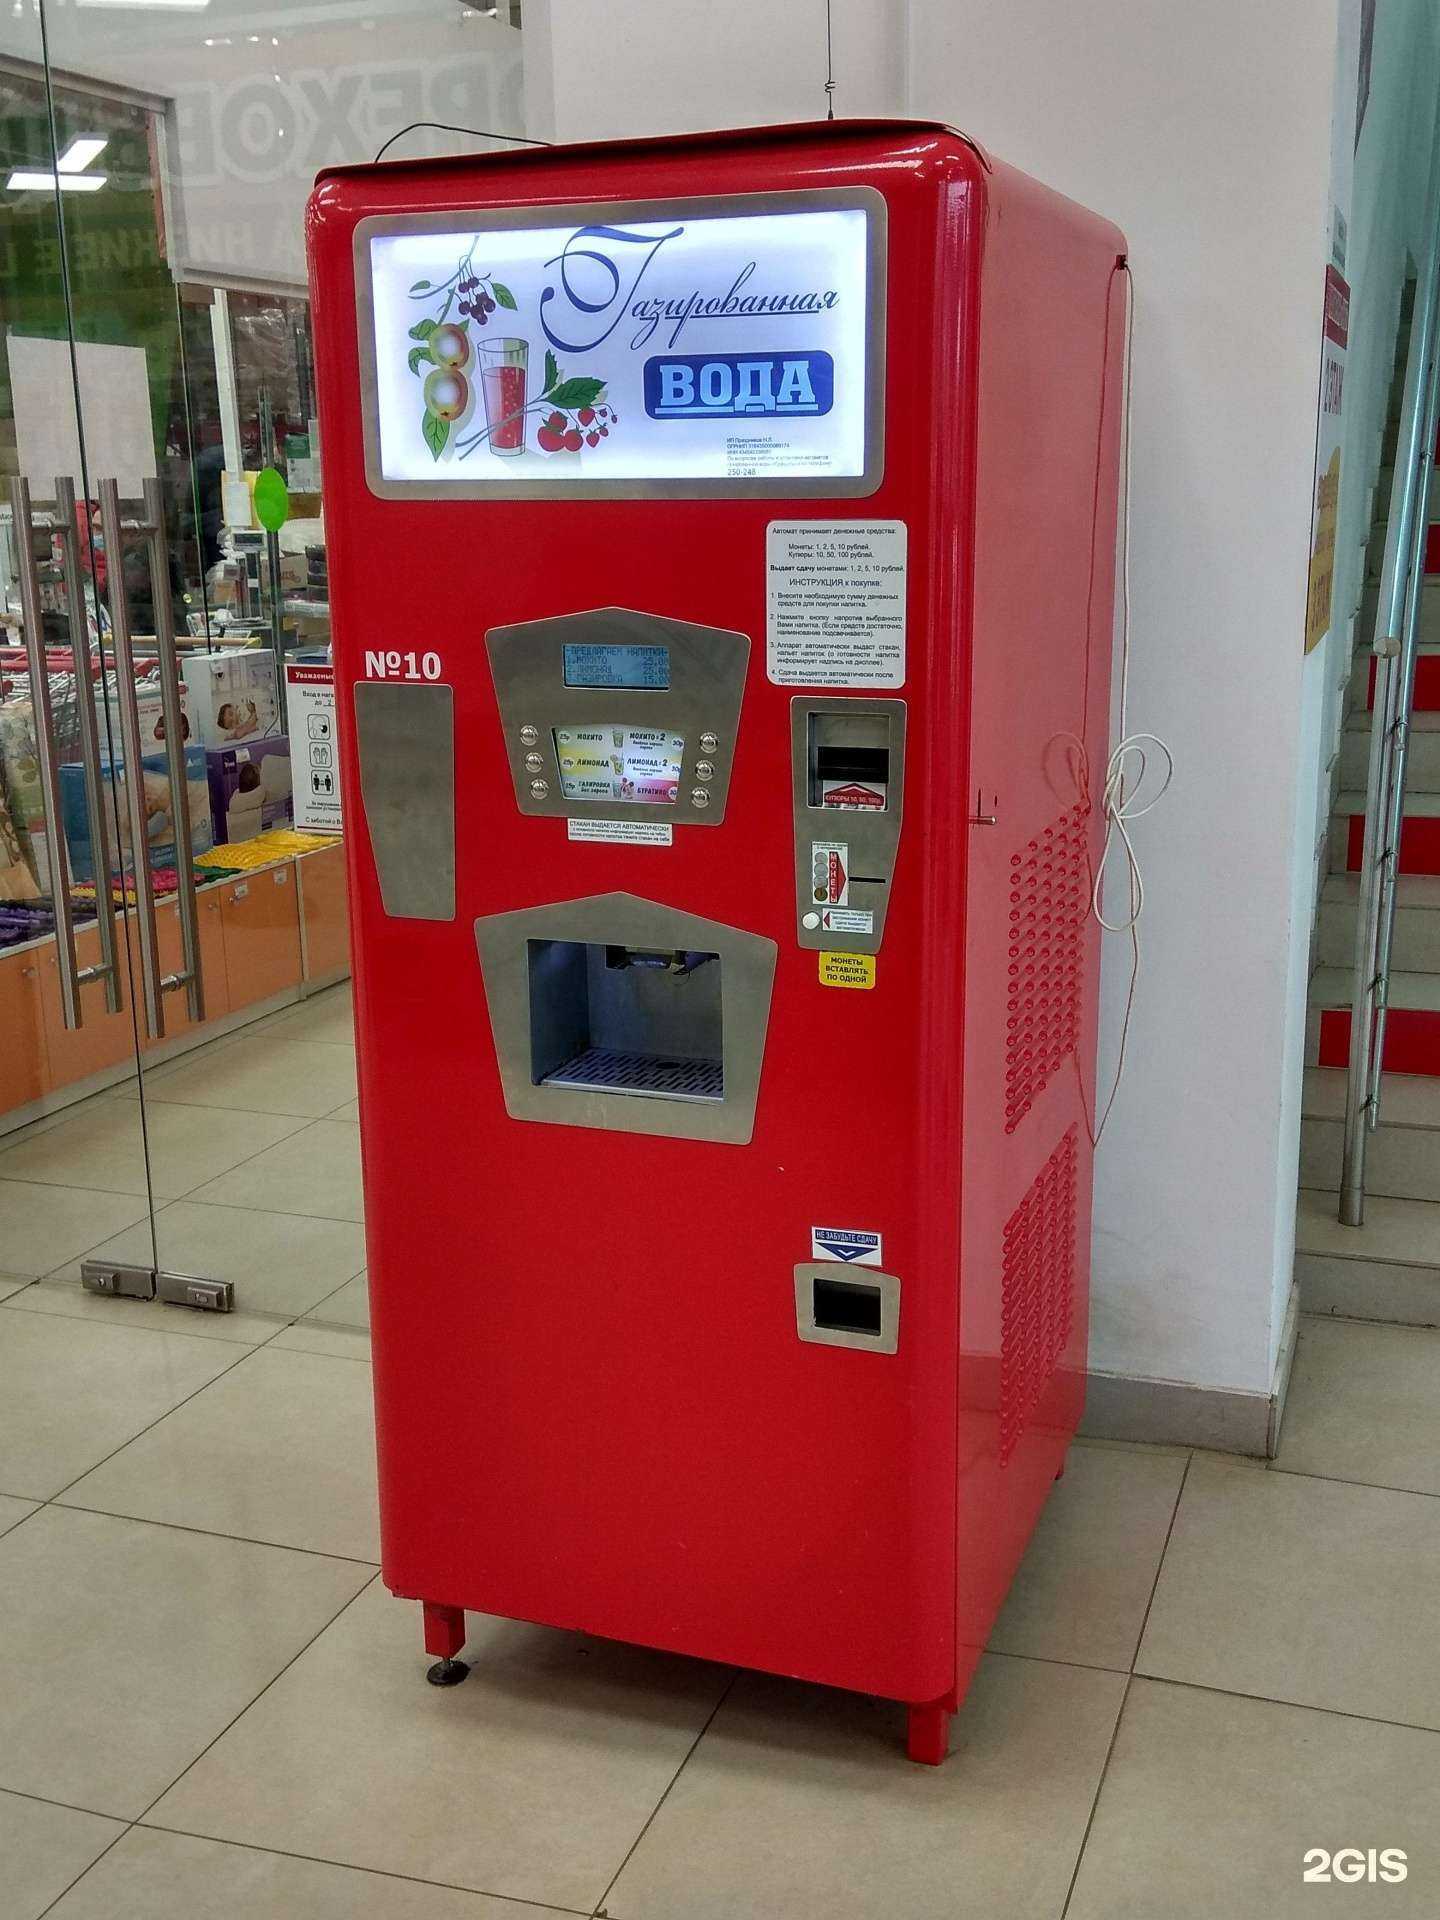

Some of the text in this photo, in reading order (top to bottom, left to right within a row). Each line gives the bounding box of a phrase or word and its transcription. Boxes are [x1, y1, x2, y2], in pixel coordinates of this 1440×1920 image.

[540, 226, 840, 353] Газированная
[657, 360, 817, 413] ВОДА
[789, 579, 843, 587] ИНСТРУКЦИЯ
[365, 651, 441, 680] №10
[831, 957, 863, 966] МОНЕТЫ
[825, 965, 869, 975] ВСТАВЛЯТЬ
[839, 975, 867, 983] ОДНОЙ
[816, 1231, 877, 1245] НЕ ЗАБУДЬТЕ СДАЧУ
